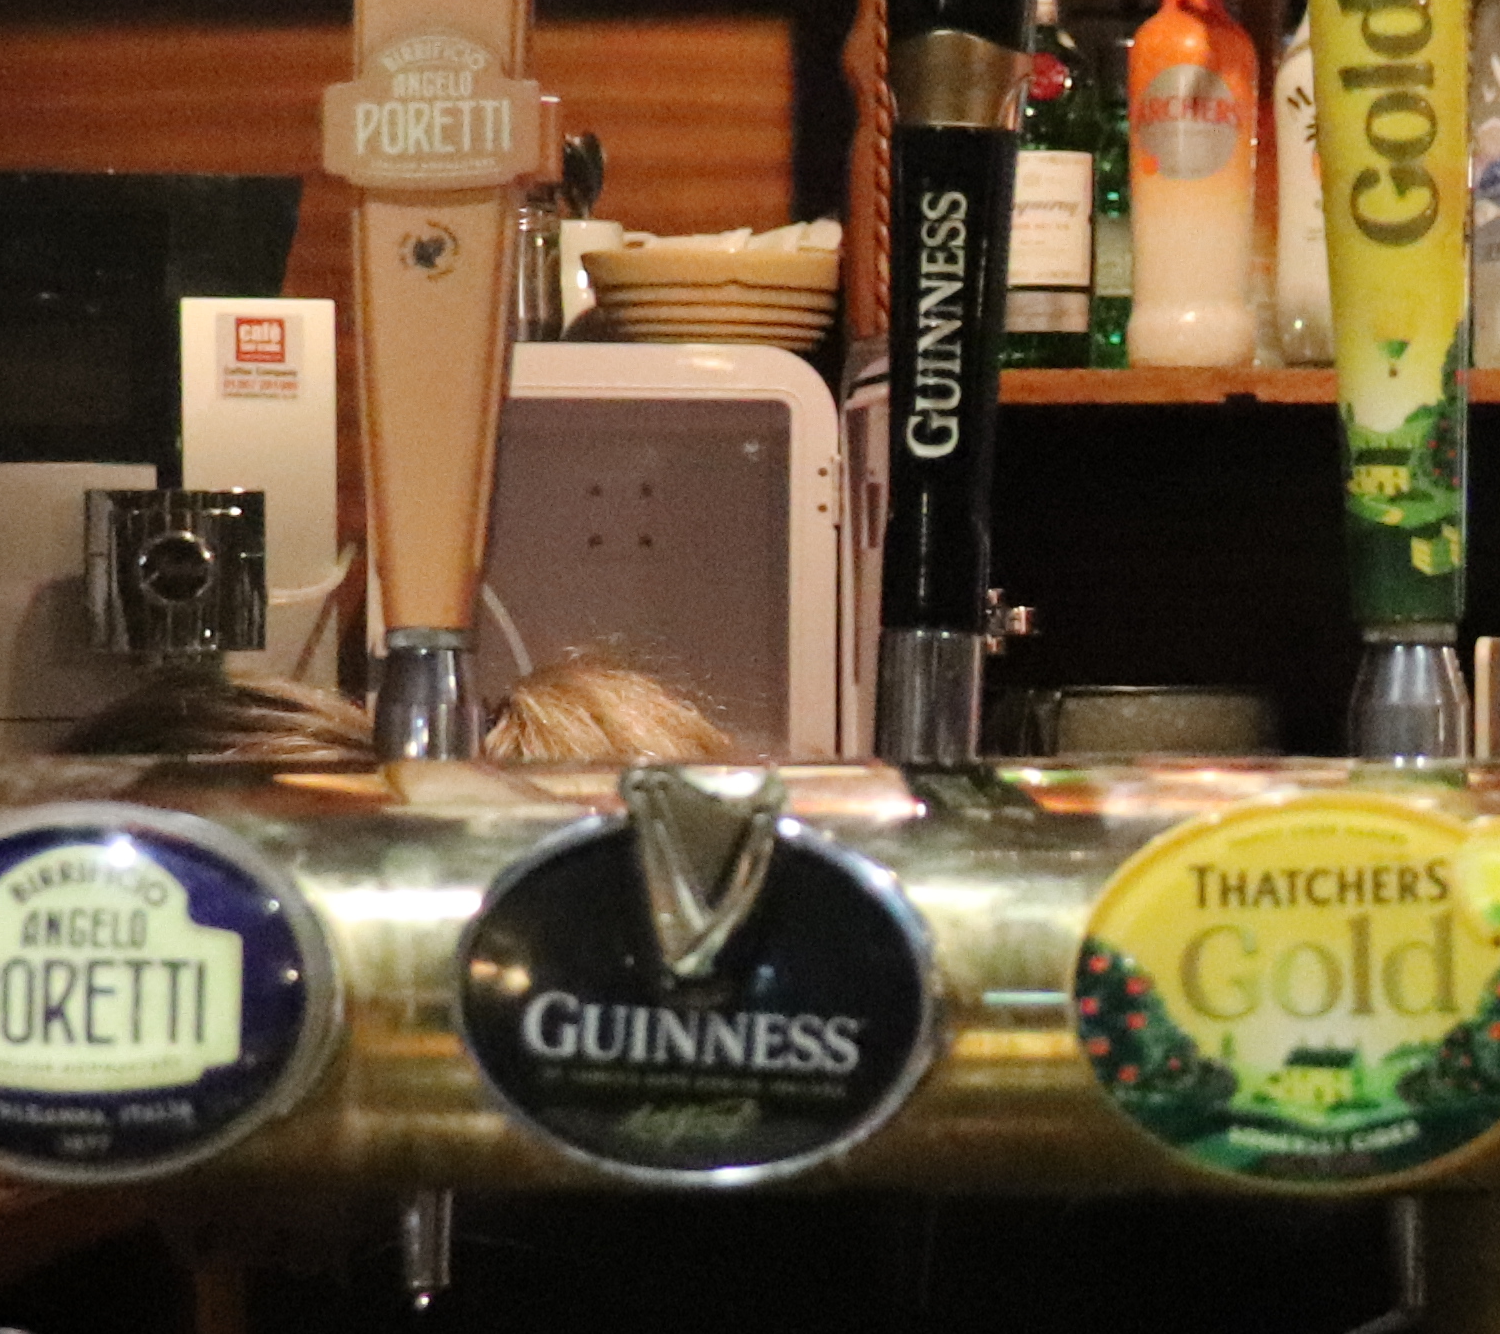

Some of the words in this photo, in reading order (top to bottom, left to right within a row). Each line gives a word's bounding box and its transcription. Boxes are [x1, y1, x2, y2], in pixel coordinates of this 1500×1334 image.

[354, 98, 513, 157] PORETTI
[906, 189, 968, 462] GUINNESS
[1189, 858, 1451, 909] THATCHERS
[19, 907, 149, 950] ANGELO
[1178, 911, 1461, 1024] Gold
[522, 990, 863, 1072] GUINNESS
